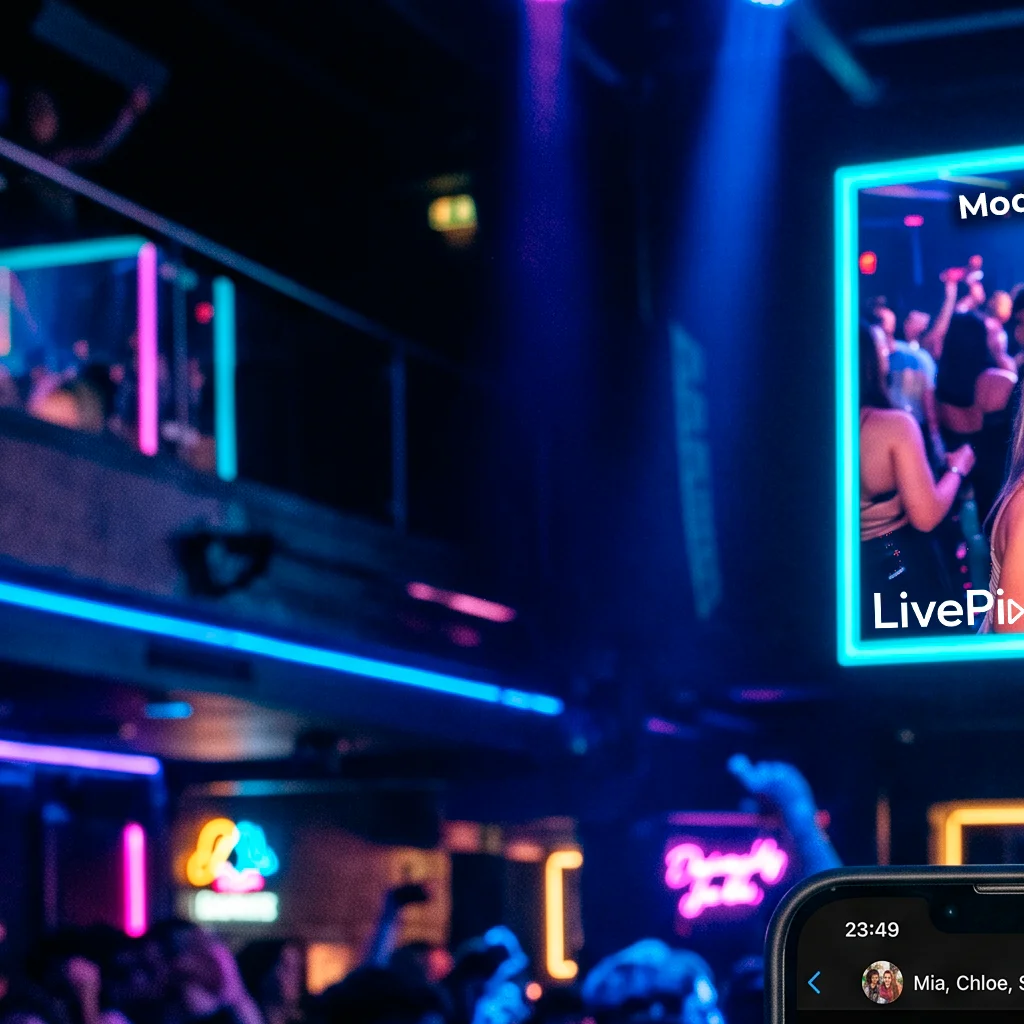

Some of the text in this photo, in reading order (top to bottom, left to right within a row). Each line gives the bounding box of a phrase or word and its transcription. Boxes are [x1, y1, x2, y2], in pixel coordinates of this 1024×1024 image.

[845, 921, 900, 938] 23:49
[914, 974, 950, 994] Mia,
[956, 974, 1013, 994] Chloe,
